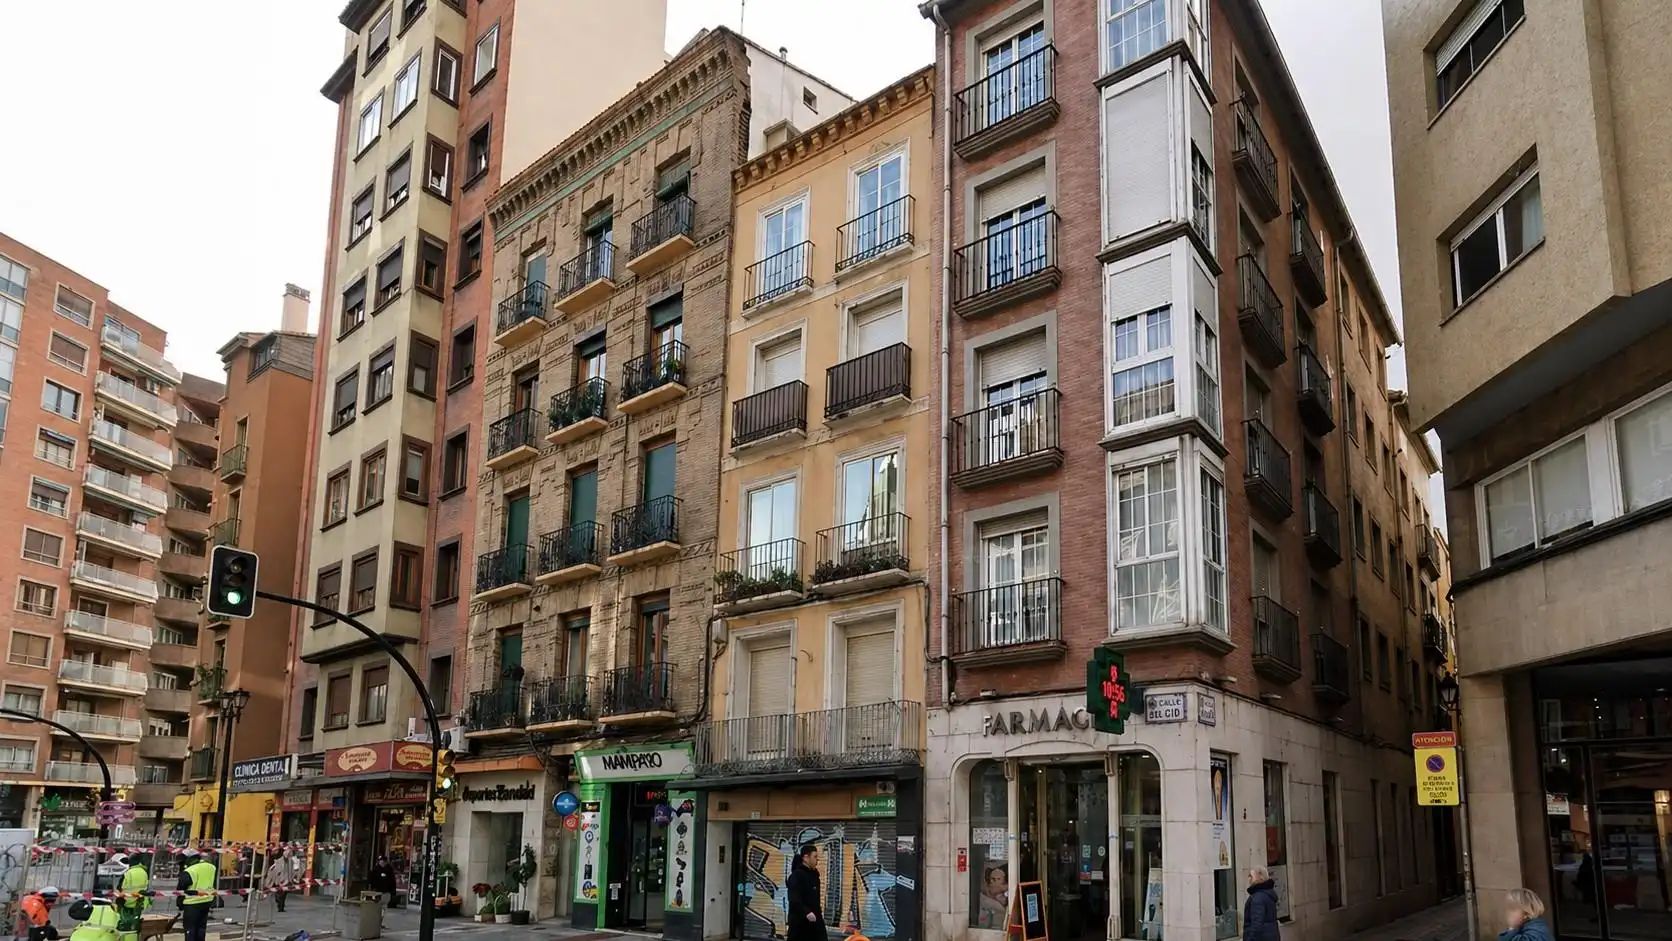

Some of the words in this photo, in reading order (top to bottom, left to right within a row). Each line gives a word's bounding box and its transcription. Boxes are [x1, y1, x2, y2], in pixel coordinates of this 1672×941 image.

[1158, 699, 1182, 707] CALLE
[1164, 708, 1180, 718] CID
[983, 706, 1096, 738] FARMACI
